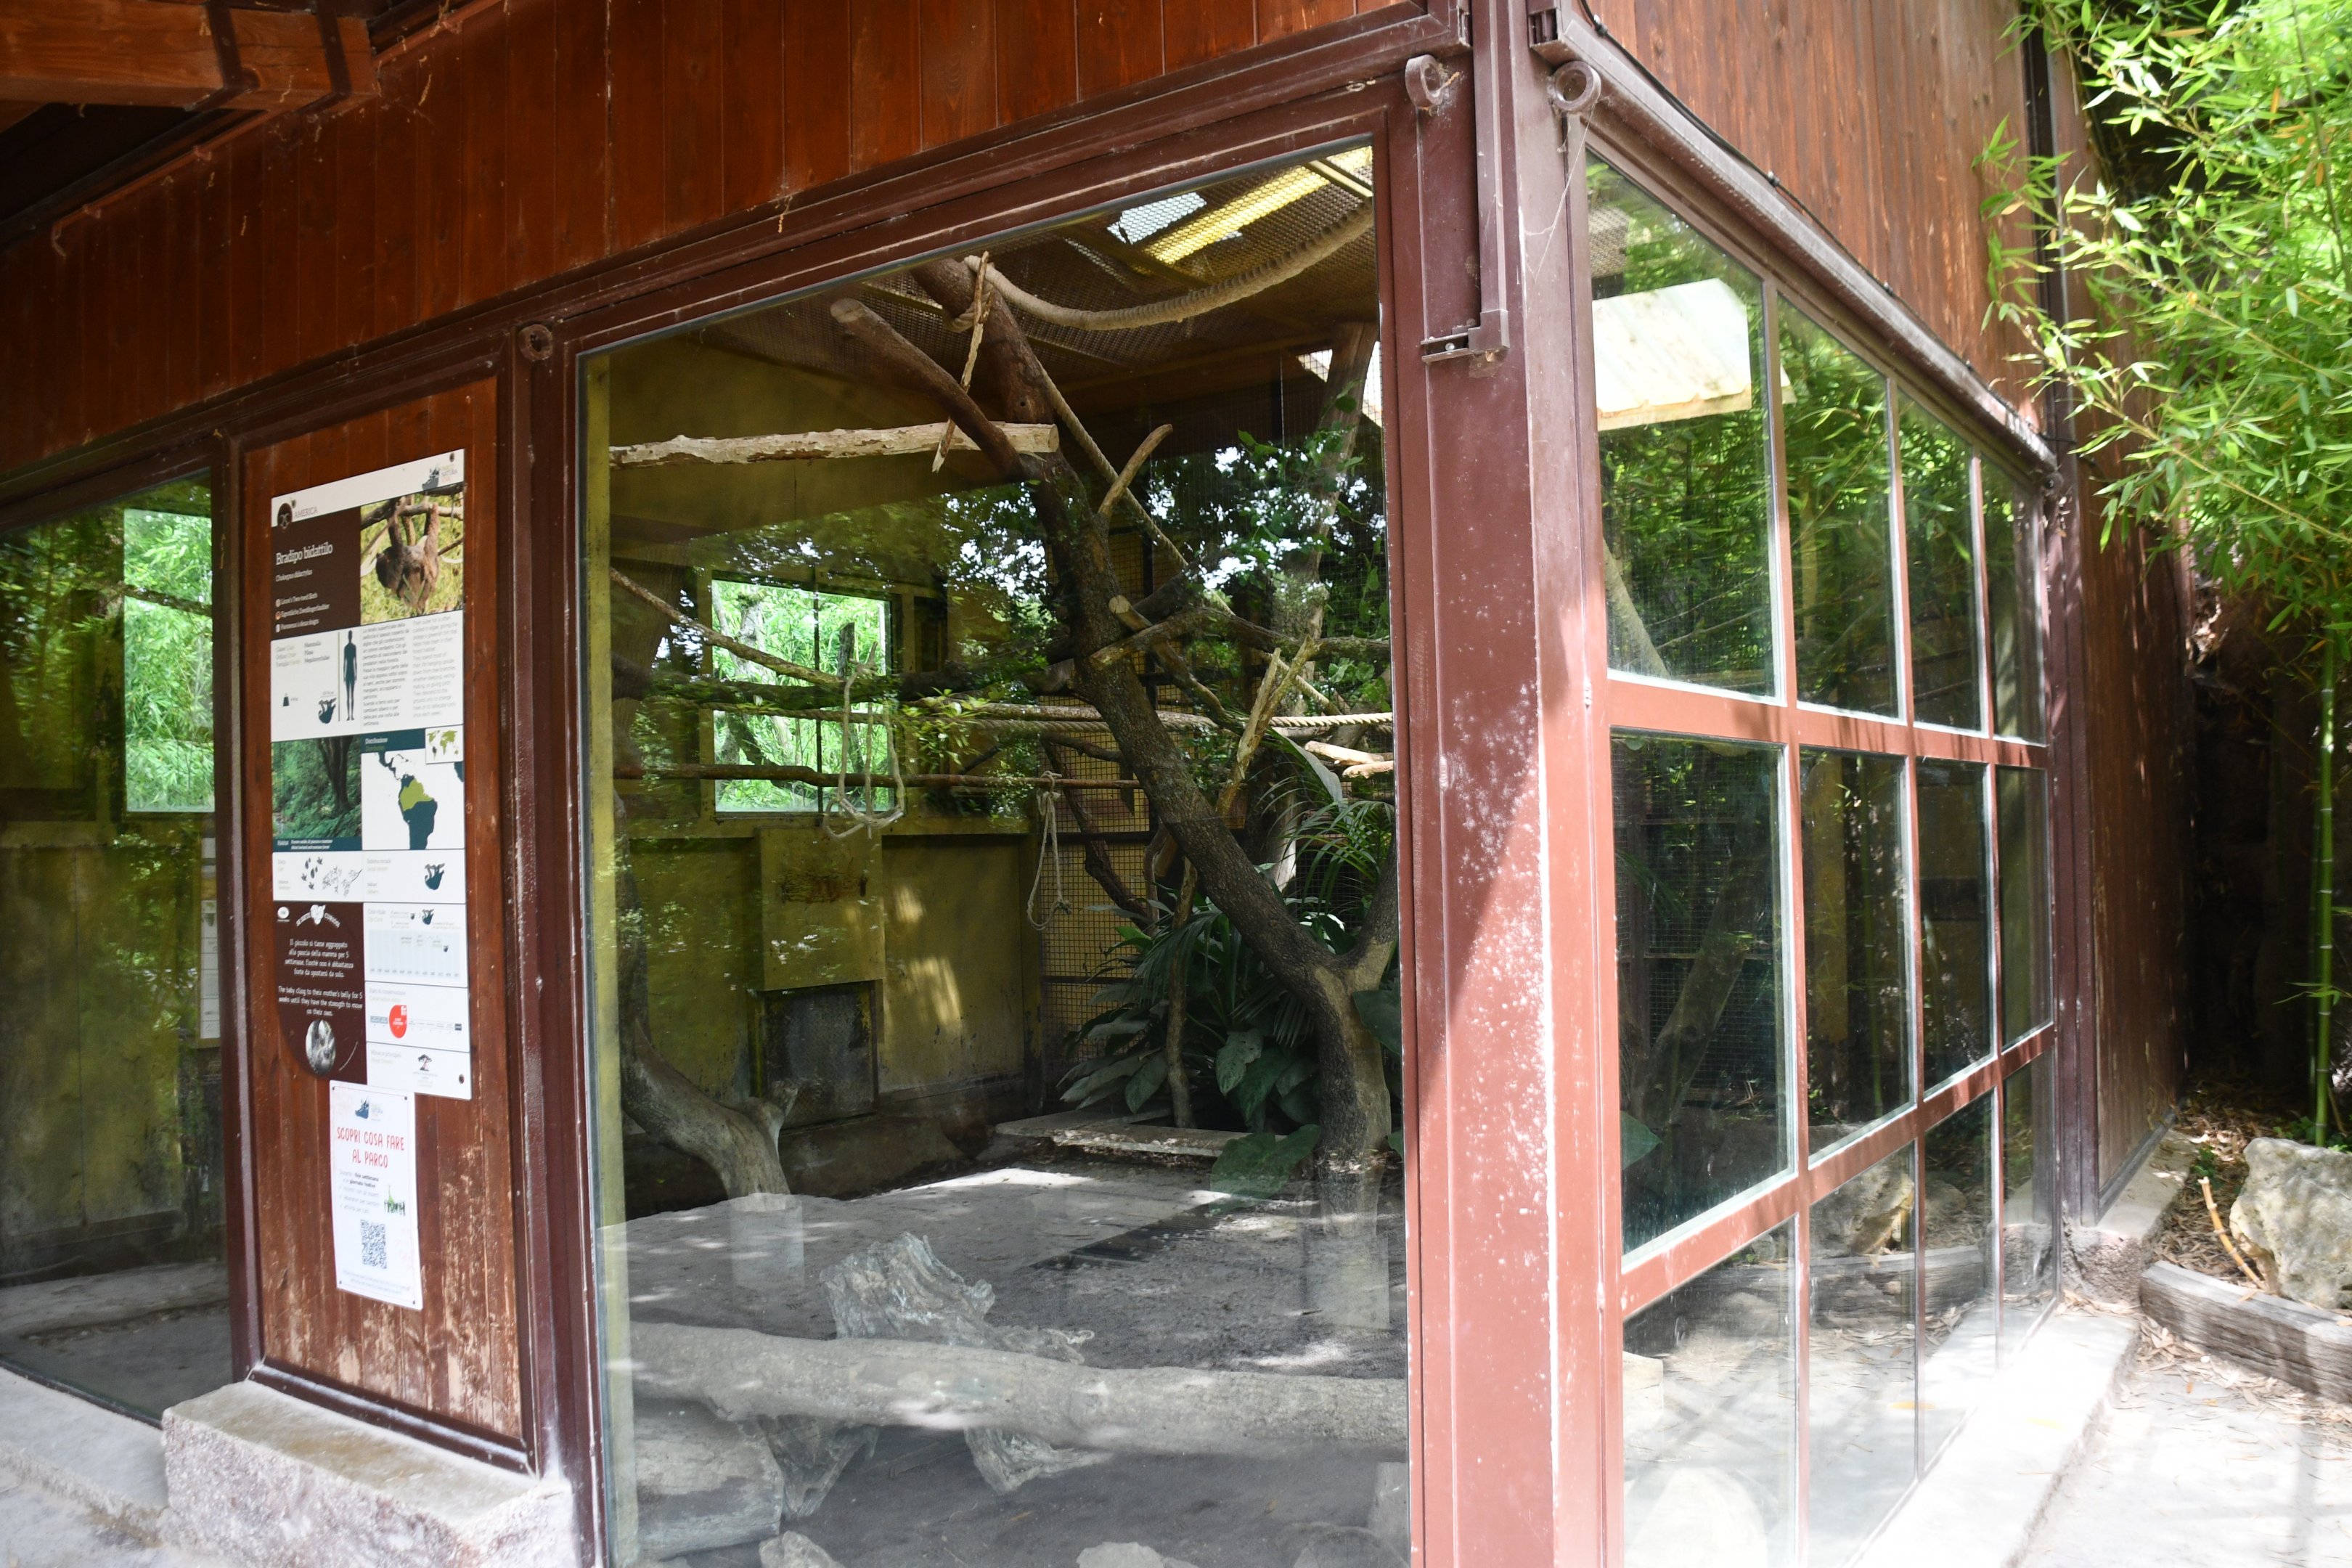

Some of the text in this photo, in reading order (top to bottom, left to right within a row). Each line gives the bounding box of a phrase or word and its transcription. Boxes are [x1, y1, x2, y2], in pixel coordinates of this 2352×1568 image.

[294, 507, 317, 518] AMERICA
[276, 542, 333, 565] Bradipo bidattilo
[296, 987, 306, 996] cling
[337, 1127, 405, 1151] SCOPRI COSA FARE
[352, 1149, 388, 1168] AL PARCO
